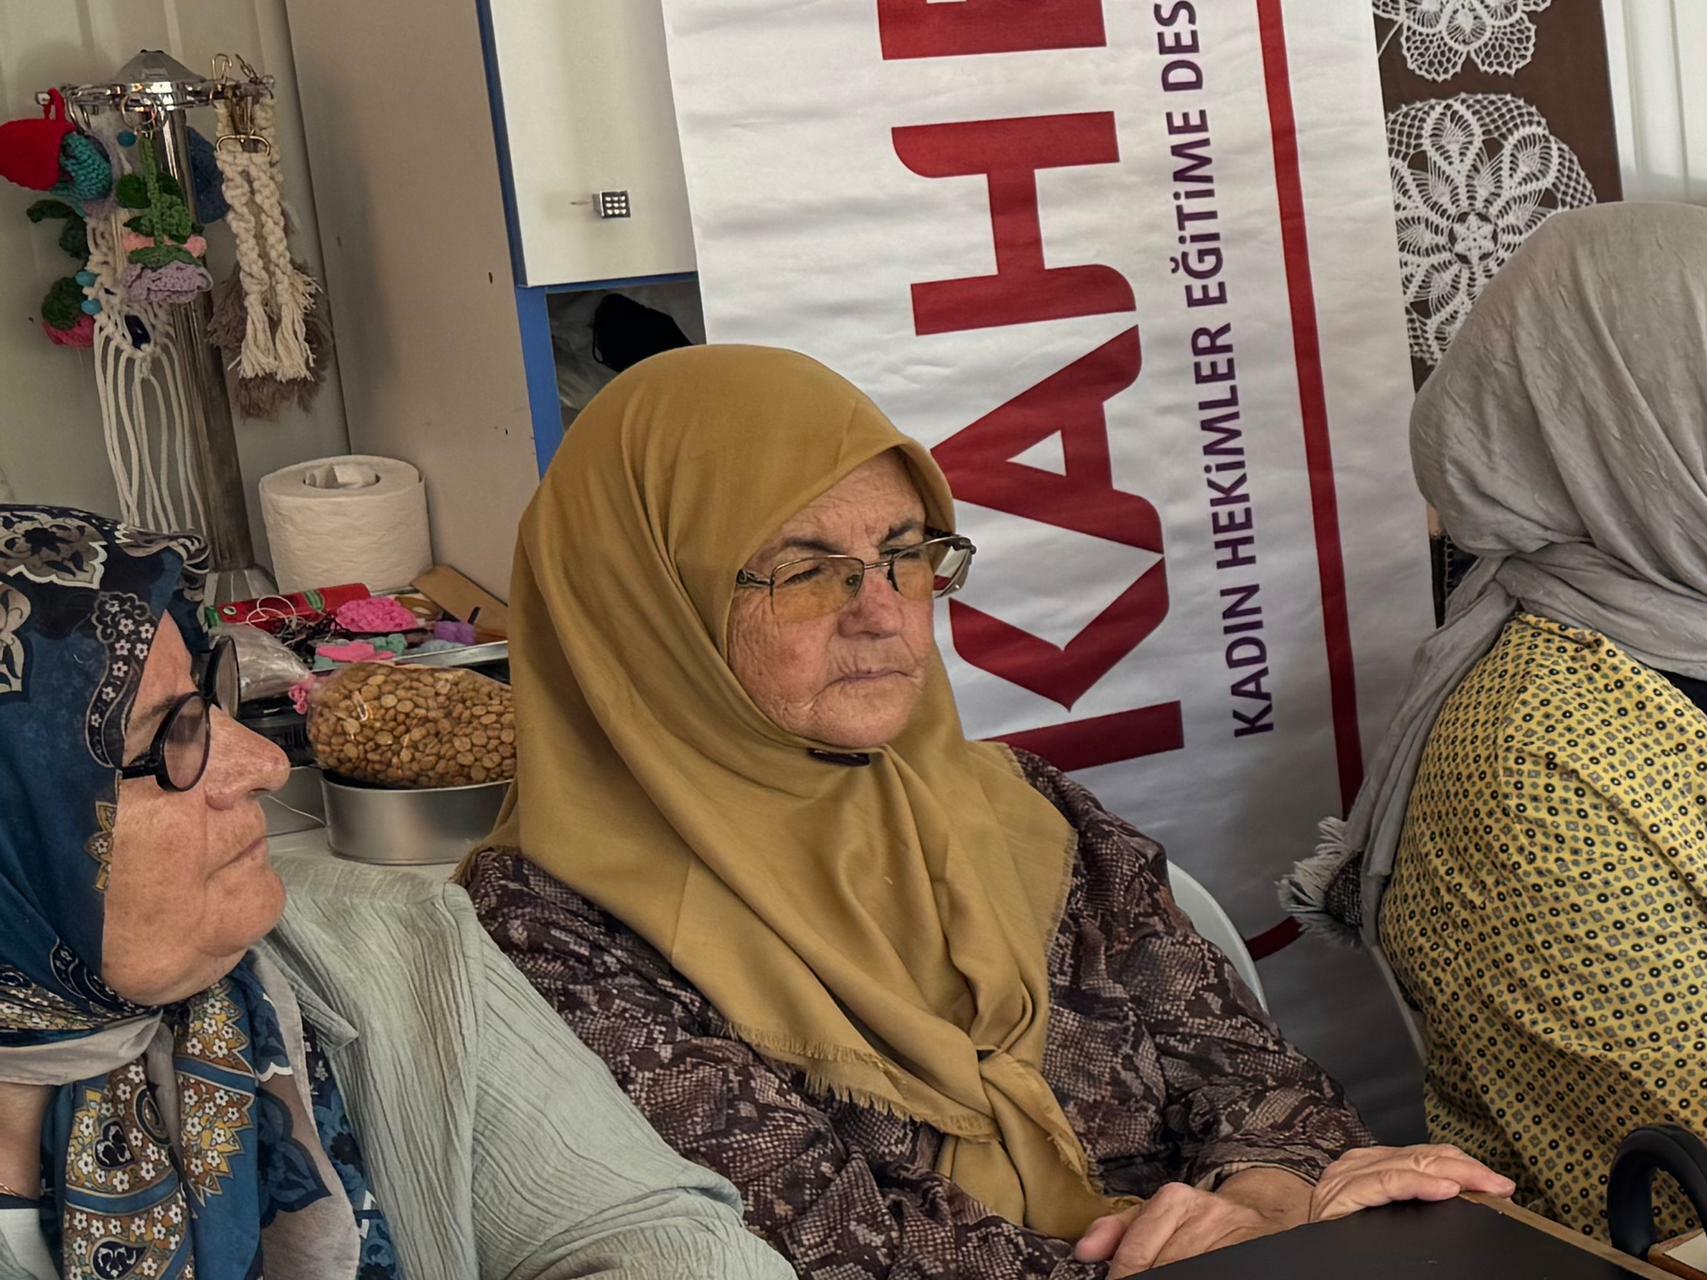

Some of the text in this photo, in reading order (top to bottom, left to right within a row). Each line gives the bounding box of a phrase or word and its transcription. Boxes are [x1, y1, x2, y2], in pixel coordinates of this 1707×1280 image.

[1165, 108, 1228, 309] EĞİTİME
[1191, 322, 1257, 570] HEKİMLER
[1218, 583, 1275, 738] KADIN
